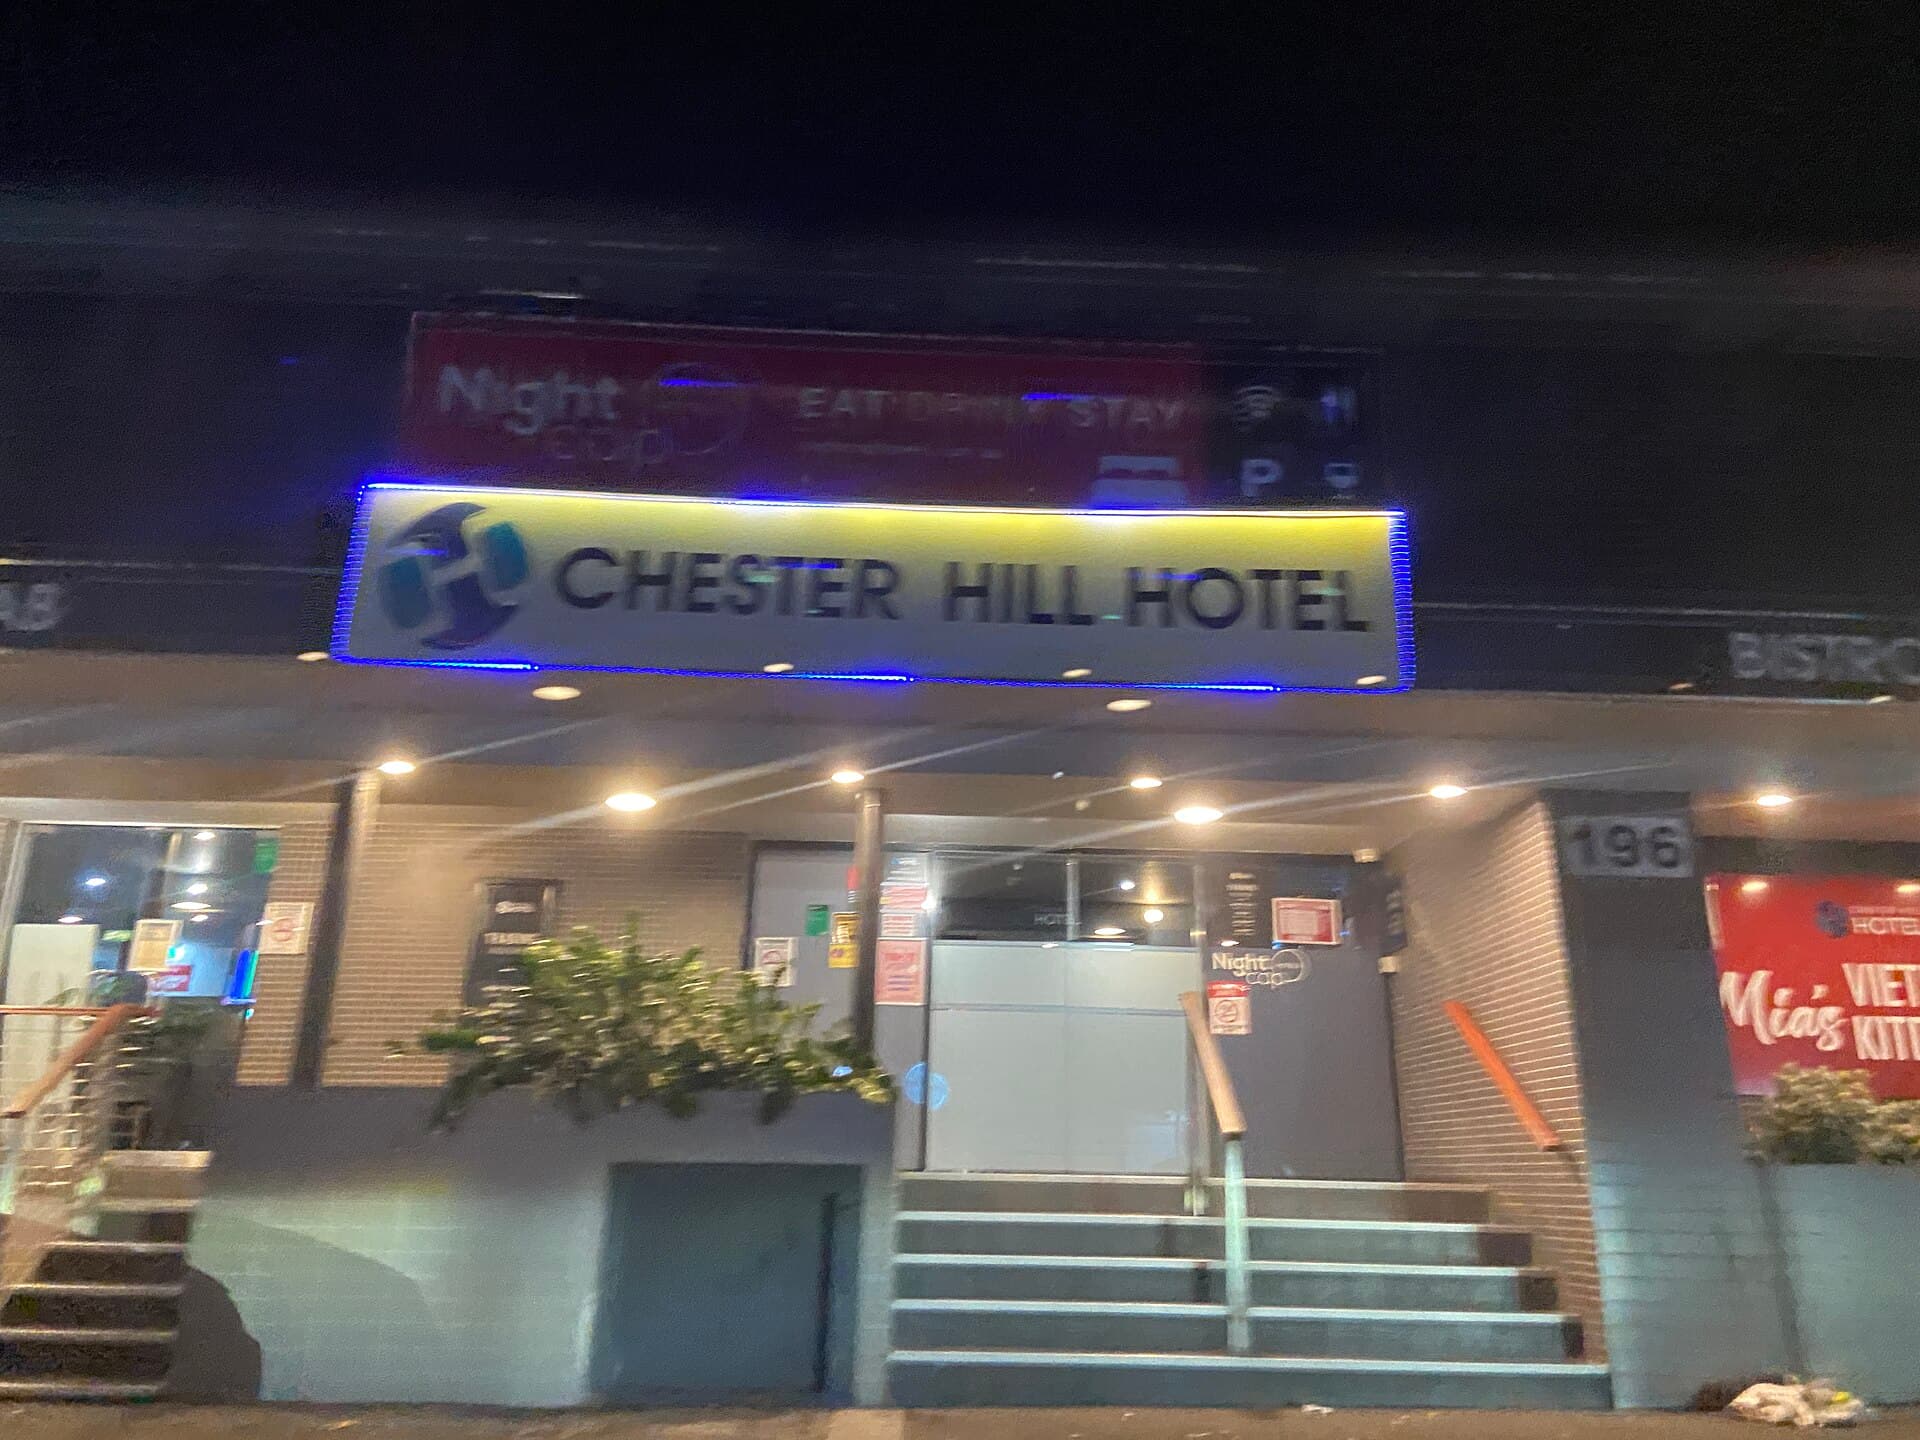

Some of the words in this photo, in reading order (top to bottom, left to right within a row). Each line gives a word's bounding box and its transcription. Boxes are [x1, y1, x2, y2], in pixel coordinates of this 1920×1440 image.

[437, 364, 621, 436] Night
[800, 388, 893, 418] EAT
[1065, 396, 1187, 429] STAY
[557, 547, 902, 621] CHESTER
[945, 562, 1094, 627] HILL
[1126, 566, 1369, 631] HOTEL
[1573, 824, 1682, 869] 196
[1212, 953, 1272, 977] Night
[1719, 970, 1849, 1051] Mia's
